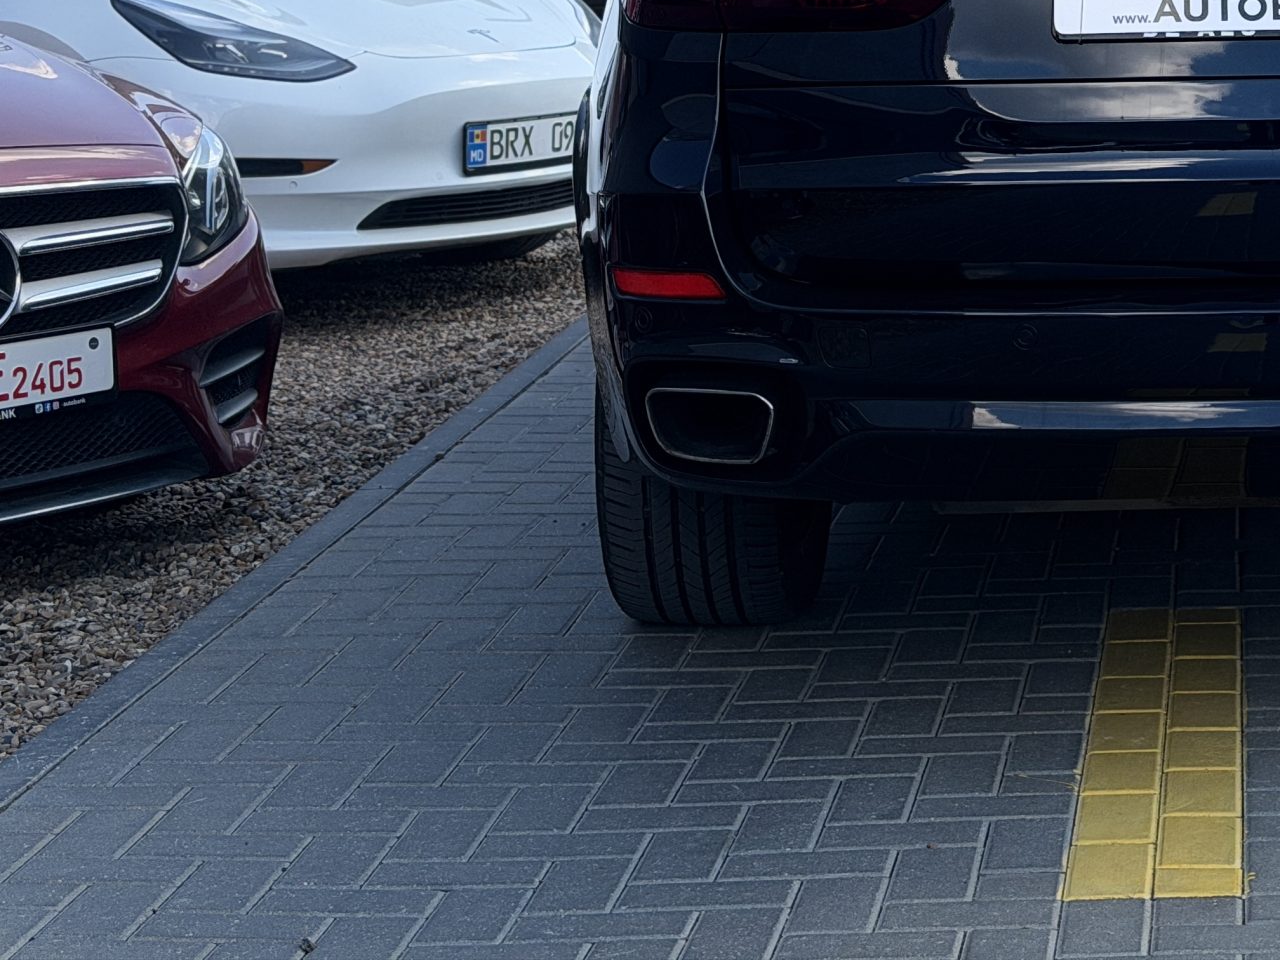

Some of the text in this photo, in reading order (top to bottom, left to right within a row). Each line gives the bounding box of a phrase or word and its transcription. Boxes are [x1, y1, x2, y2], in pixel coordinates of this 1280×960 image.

[470, 121, 574, 162] MD BRX 09
